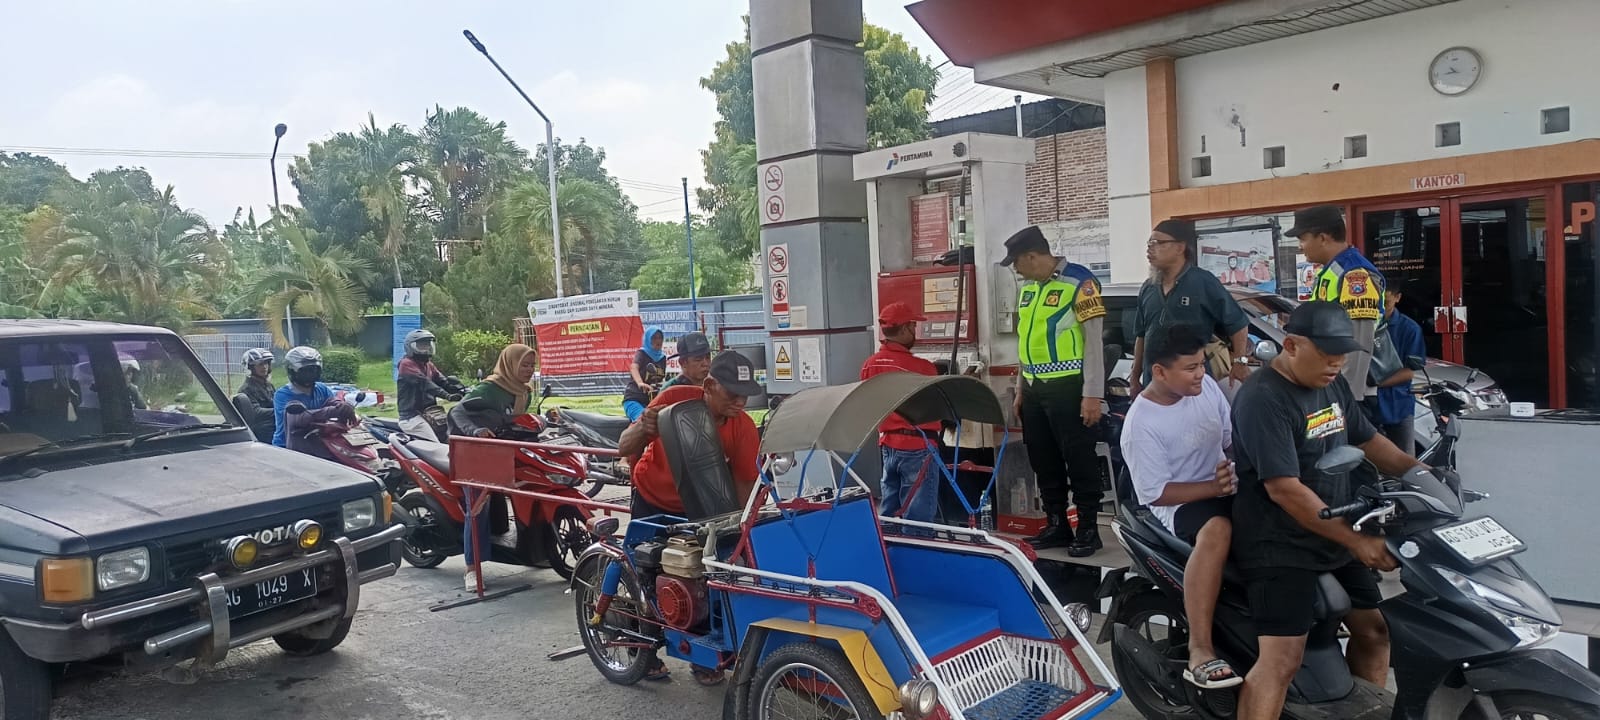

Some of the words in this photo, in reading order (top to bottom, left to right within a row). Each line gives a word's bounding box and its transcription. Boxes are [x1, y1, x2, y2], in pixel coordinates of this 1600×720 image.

[900, 150, 933, 162] PERTAMINA
[1416, 174, 1460, 189] KANTOR
[1440, 530, 1461, 544] AG
[226, 588, 241, 607] AG
[256, 575, 288, 599] 1049
[302, 568, 311, 587] X
[258, 596, 282, 608] 01-27
